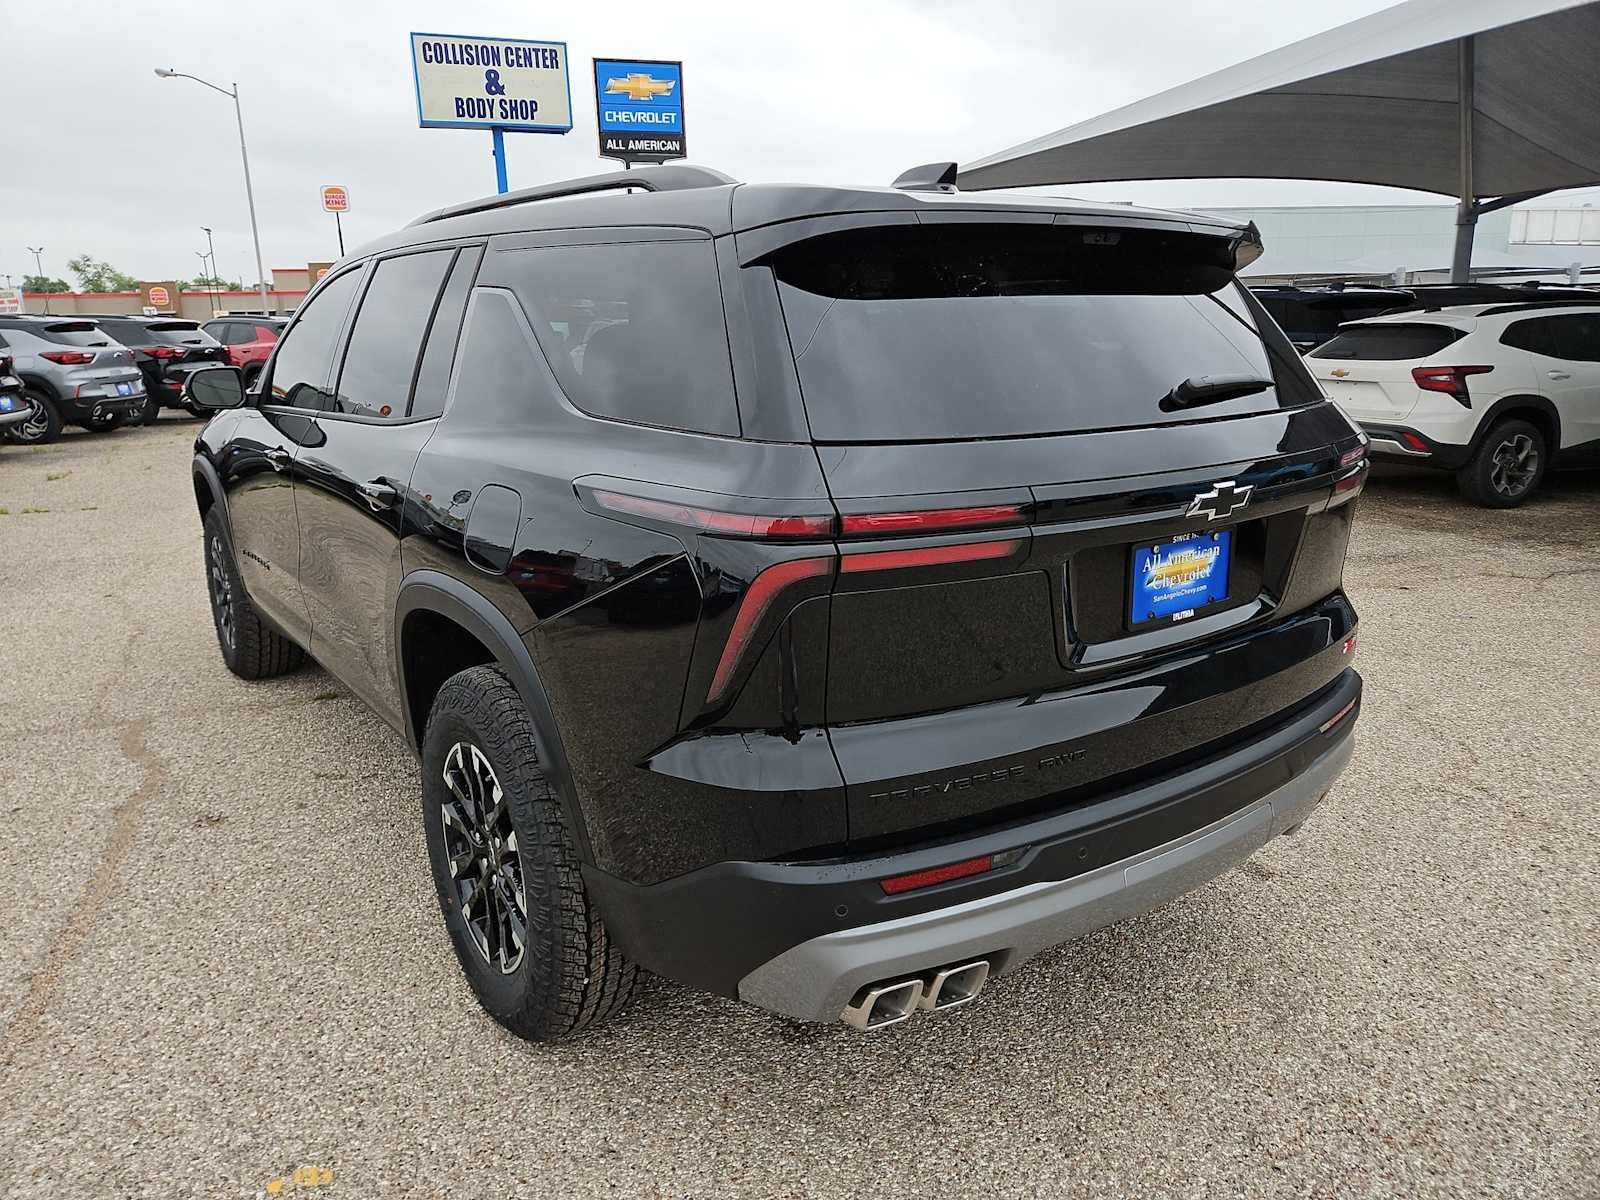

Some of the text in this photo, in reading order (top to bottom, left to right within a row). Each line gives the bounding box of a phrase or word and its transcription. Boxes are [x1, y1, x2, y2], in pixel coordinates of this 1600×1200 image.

[422, 41, 560, 70] COLLISION CENTER
[484, 69, 506, 96] &
[455, 97, 538, 121] BODY SHOP
[604, 110, 677, 124] CHEVROLET
[606, 139, 680, 152] ALL AMERICAN
[1142, 545, 1221, 573] All American
[1152, 564, 1211, 590] Chevrolet
[1153, 584, 1208, 603] SanAngeloChevy.com
[868, 764, 1026, 802] TRAVERSE
